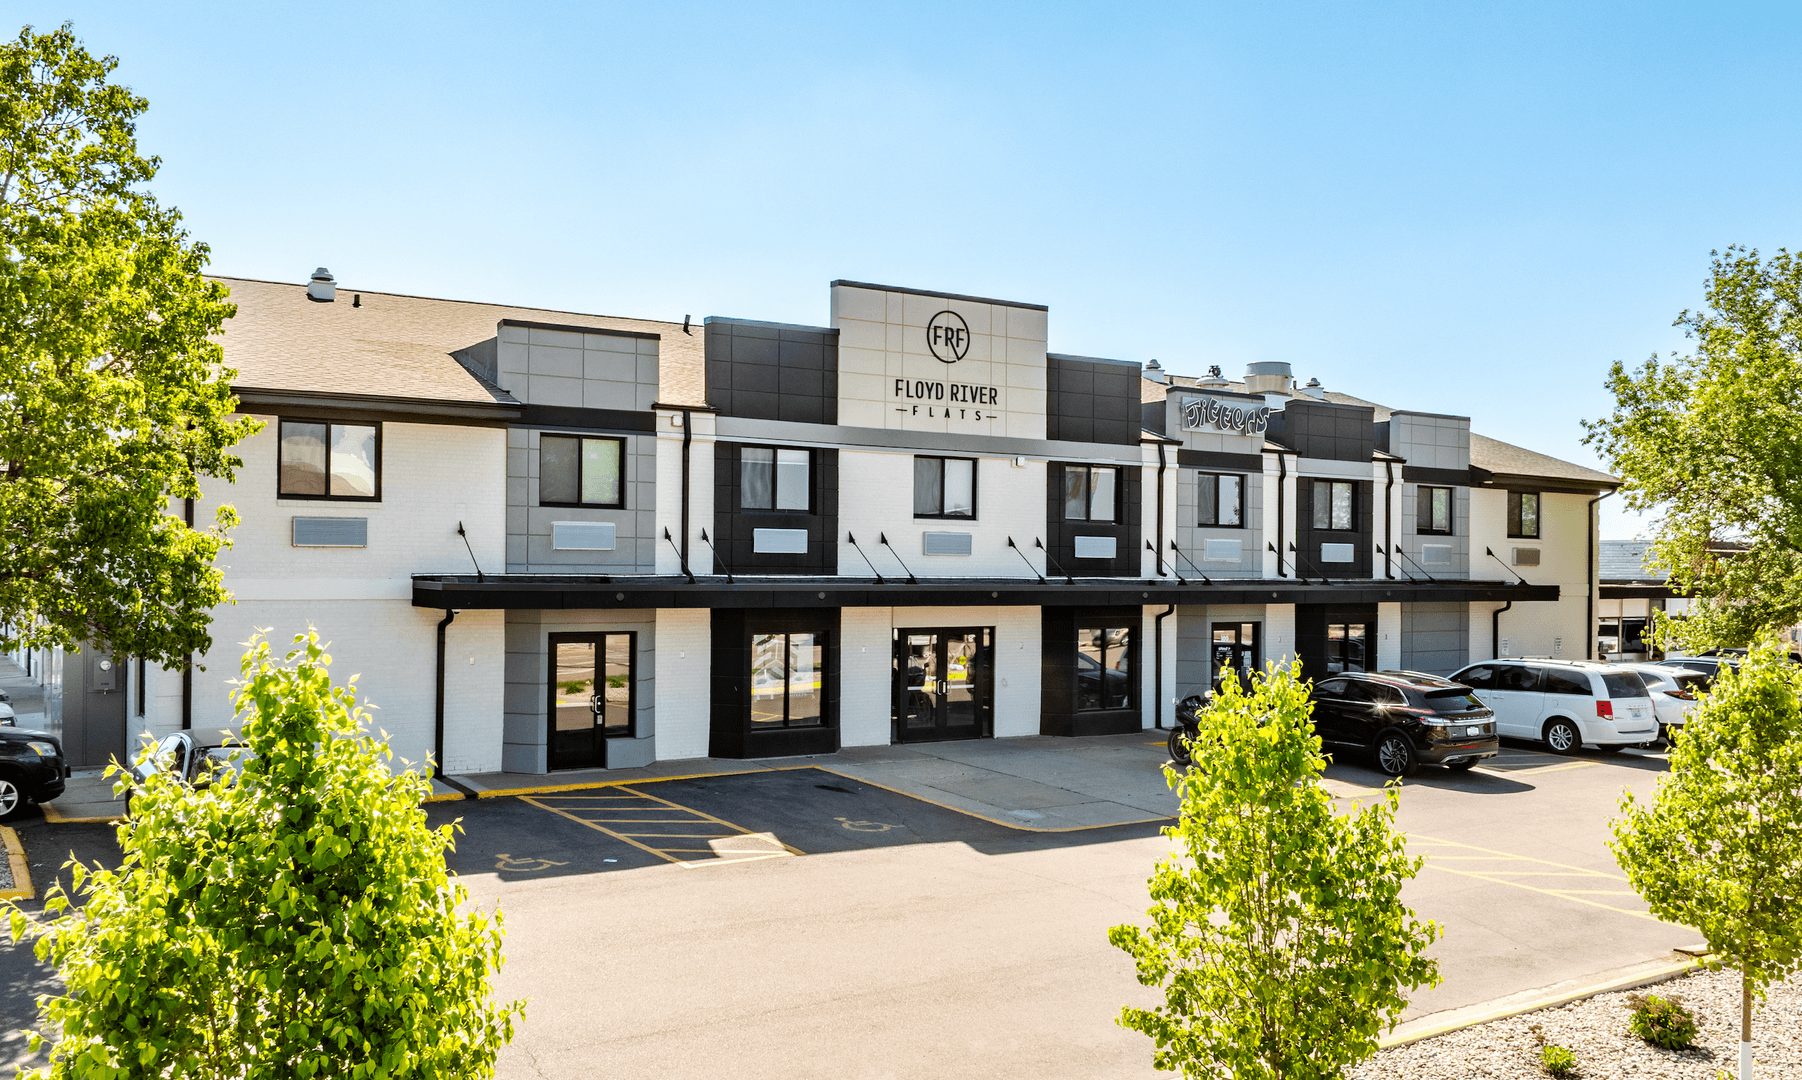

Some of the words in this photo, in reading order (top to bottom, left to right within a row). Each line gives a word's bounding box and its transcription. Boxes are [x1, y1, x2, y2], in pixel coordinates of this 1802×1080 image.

[933, 325, 965, 361] FRF
[895, 379, 944, 400] FLOYD
[950, 383, 998, 405] RIVER
[912, 405, 981, 421] FLATS
